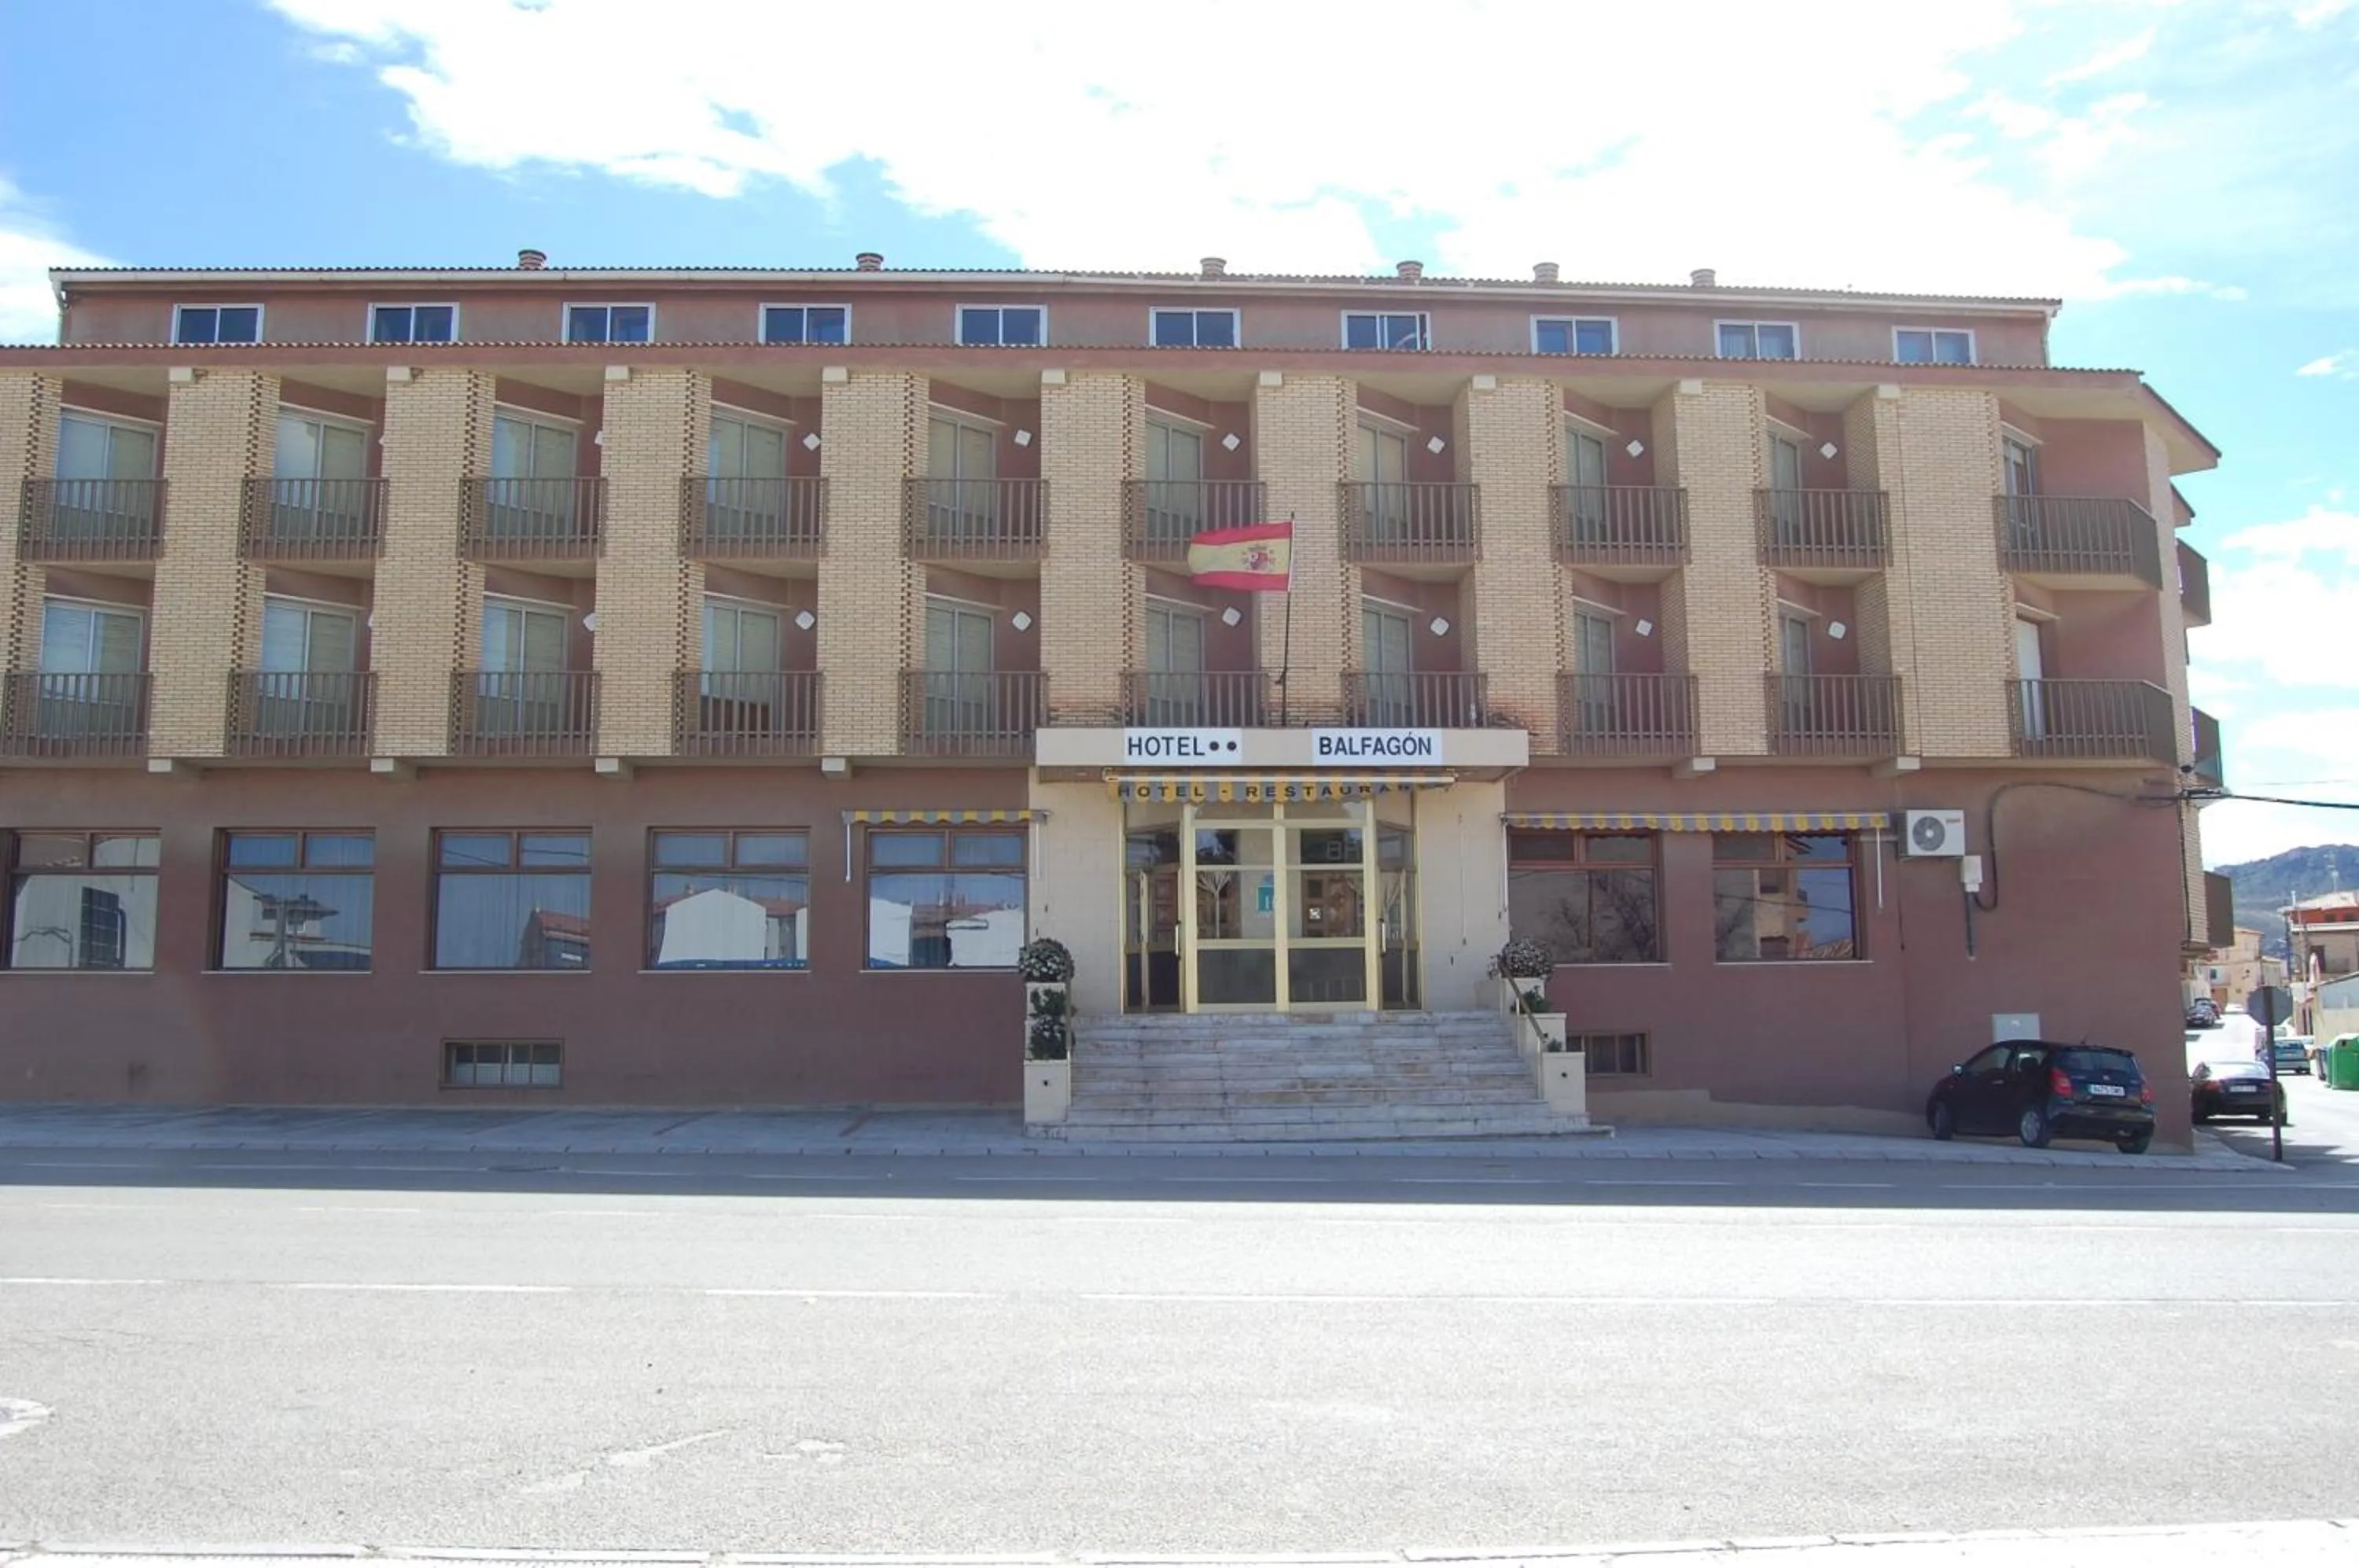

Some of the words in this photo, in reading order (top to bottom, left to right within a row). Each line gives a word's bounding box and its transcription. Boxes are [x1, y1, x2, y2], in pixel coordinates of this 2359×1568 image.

[1128, 736, 1205, 756] HOTEL
[1319, 731, 1432, 756] BALFAGÓN
[1118, 786, 1204, 797] HOTEL
